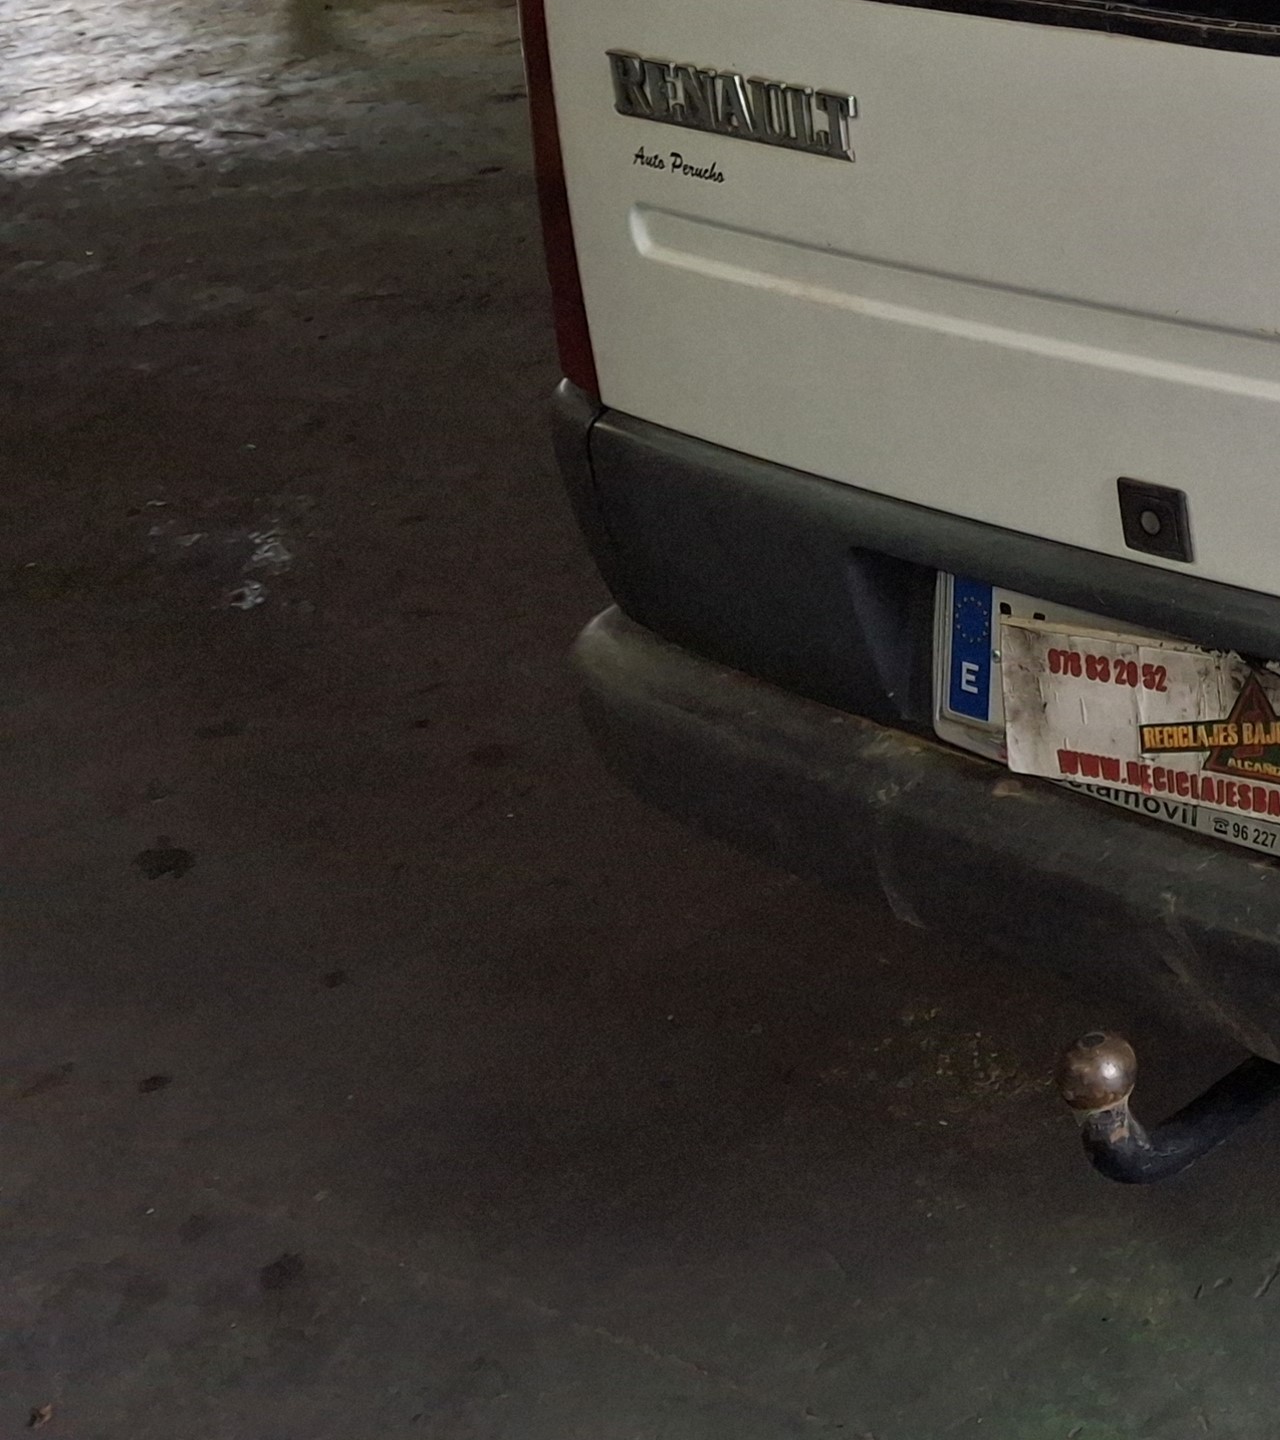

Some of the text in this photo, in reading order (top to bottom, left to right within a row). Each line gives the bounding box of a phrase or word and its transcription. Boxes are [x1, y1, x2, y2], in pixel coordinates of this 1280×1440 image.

[605, 48, 857, 163] RENAULT
[960, 661, 980, 695] E
[1113, 658, 1139, 688] 20
[1142, 663, 1168, 693] 52
[1142, 723, 1239, 749] RECICLAJES
[1232, 822, 1249, 841] 96
[1252, 828, 1278, 849] 227
